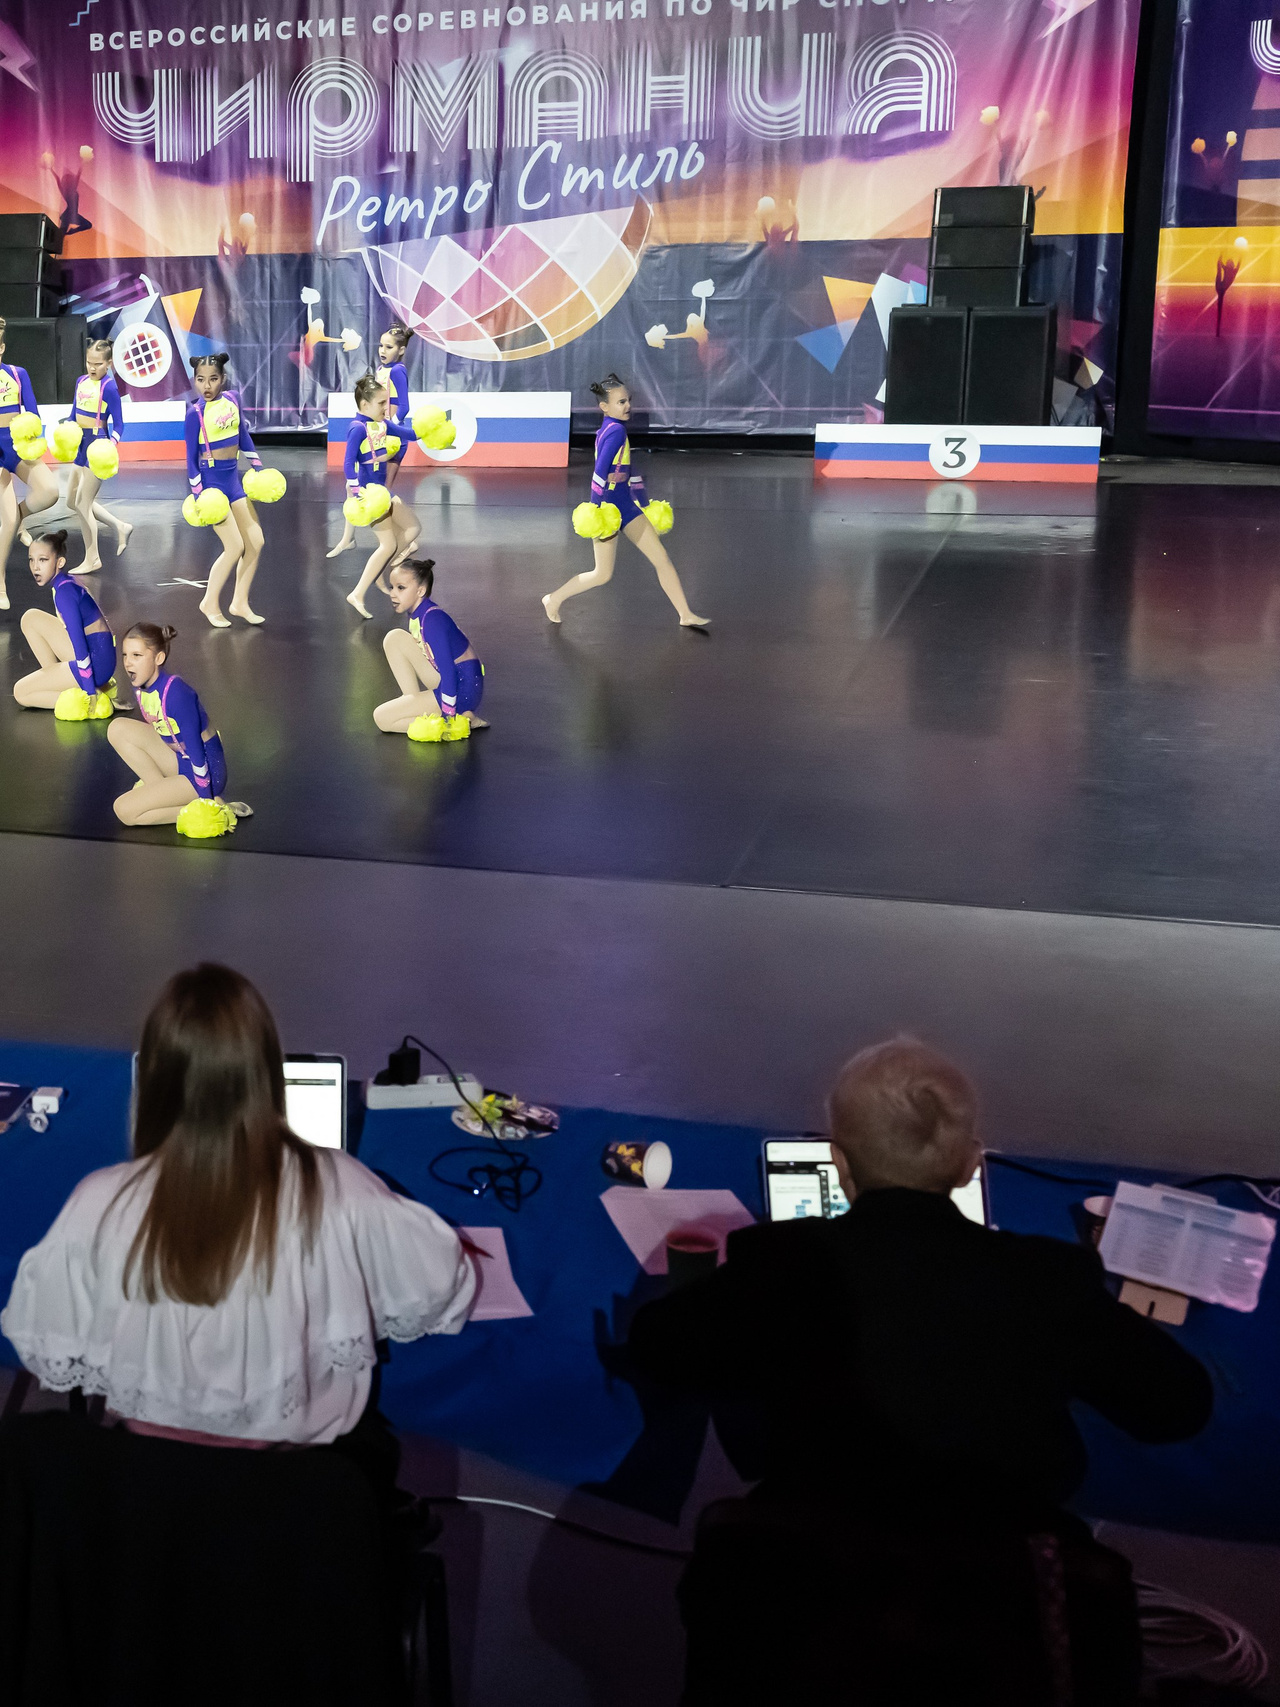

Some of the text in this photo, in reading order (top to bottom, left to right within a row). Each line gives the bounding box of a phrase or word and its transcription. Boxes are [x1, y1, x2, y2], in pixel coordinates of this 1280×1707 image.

[89, 17, 357, 52] ВСЕРОССИЙСКИЕ
[371, 0, 648, 34] СОРЕВНОВАНИЯ
[666, 0, 713, 17] ПО
[316, 139, 706, 246] Ретро Стиль
[942, 437, 967, 469] 3
